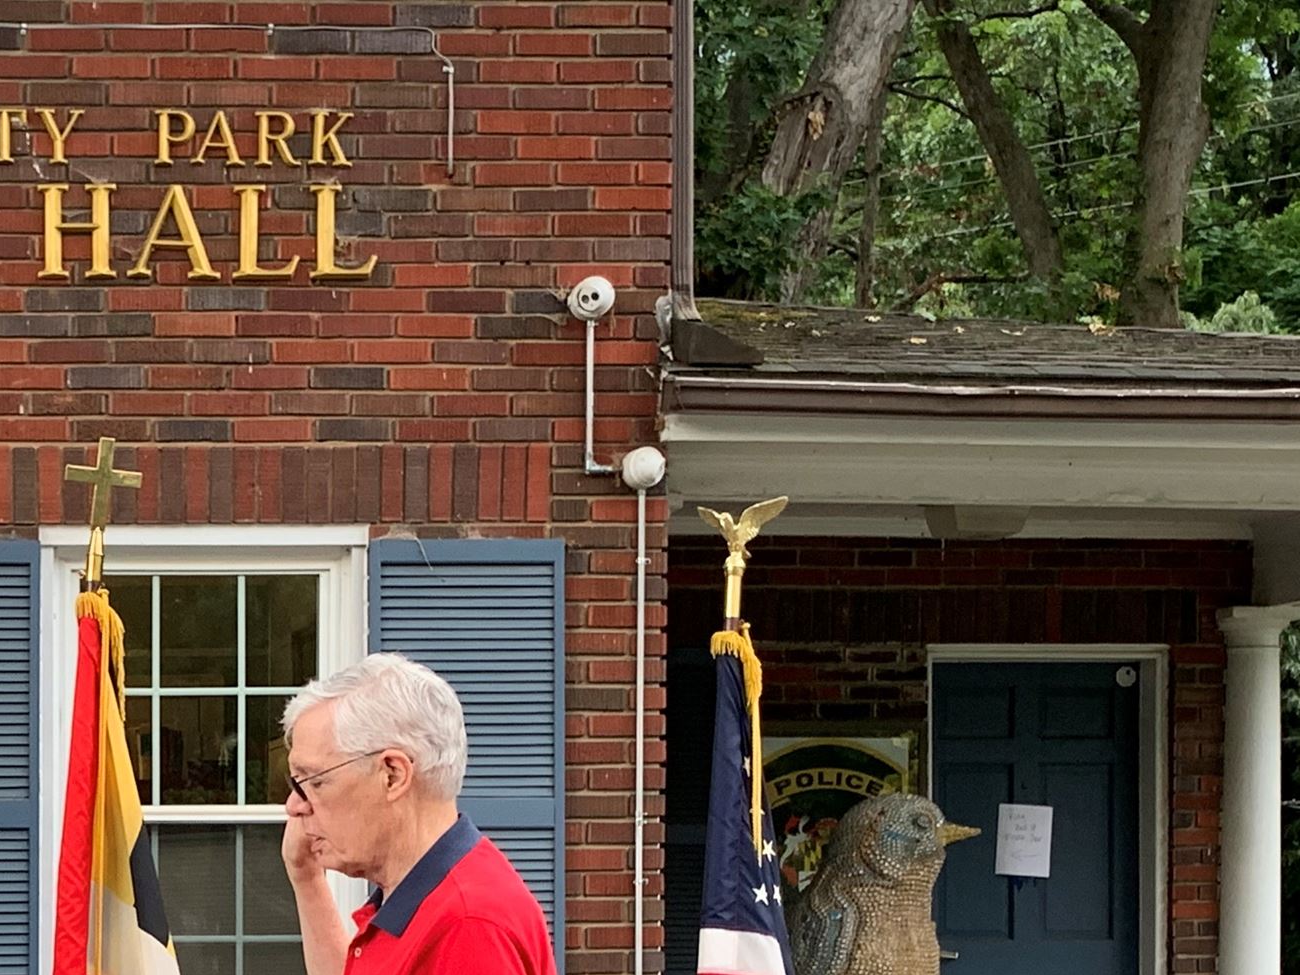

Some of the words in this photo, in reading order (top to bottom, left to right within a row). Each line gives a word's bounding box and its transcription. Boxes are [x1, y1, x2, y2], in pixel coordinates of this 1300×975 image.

[154, 109, 354, 168] PARK
[37, 183, 378, 280] HALL
[773, 771, 884, 797] POLICE
